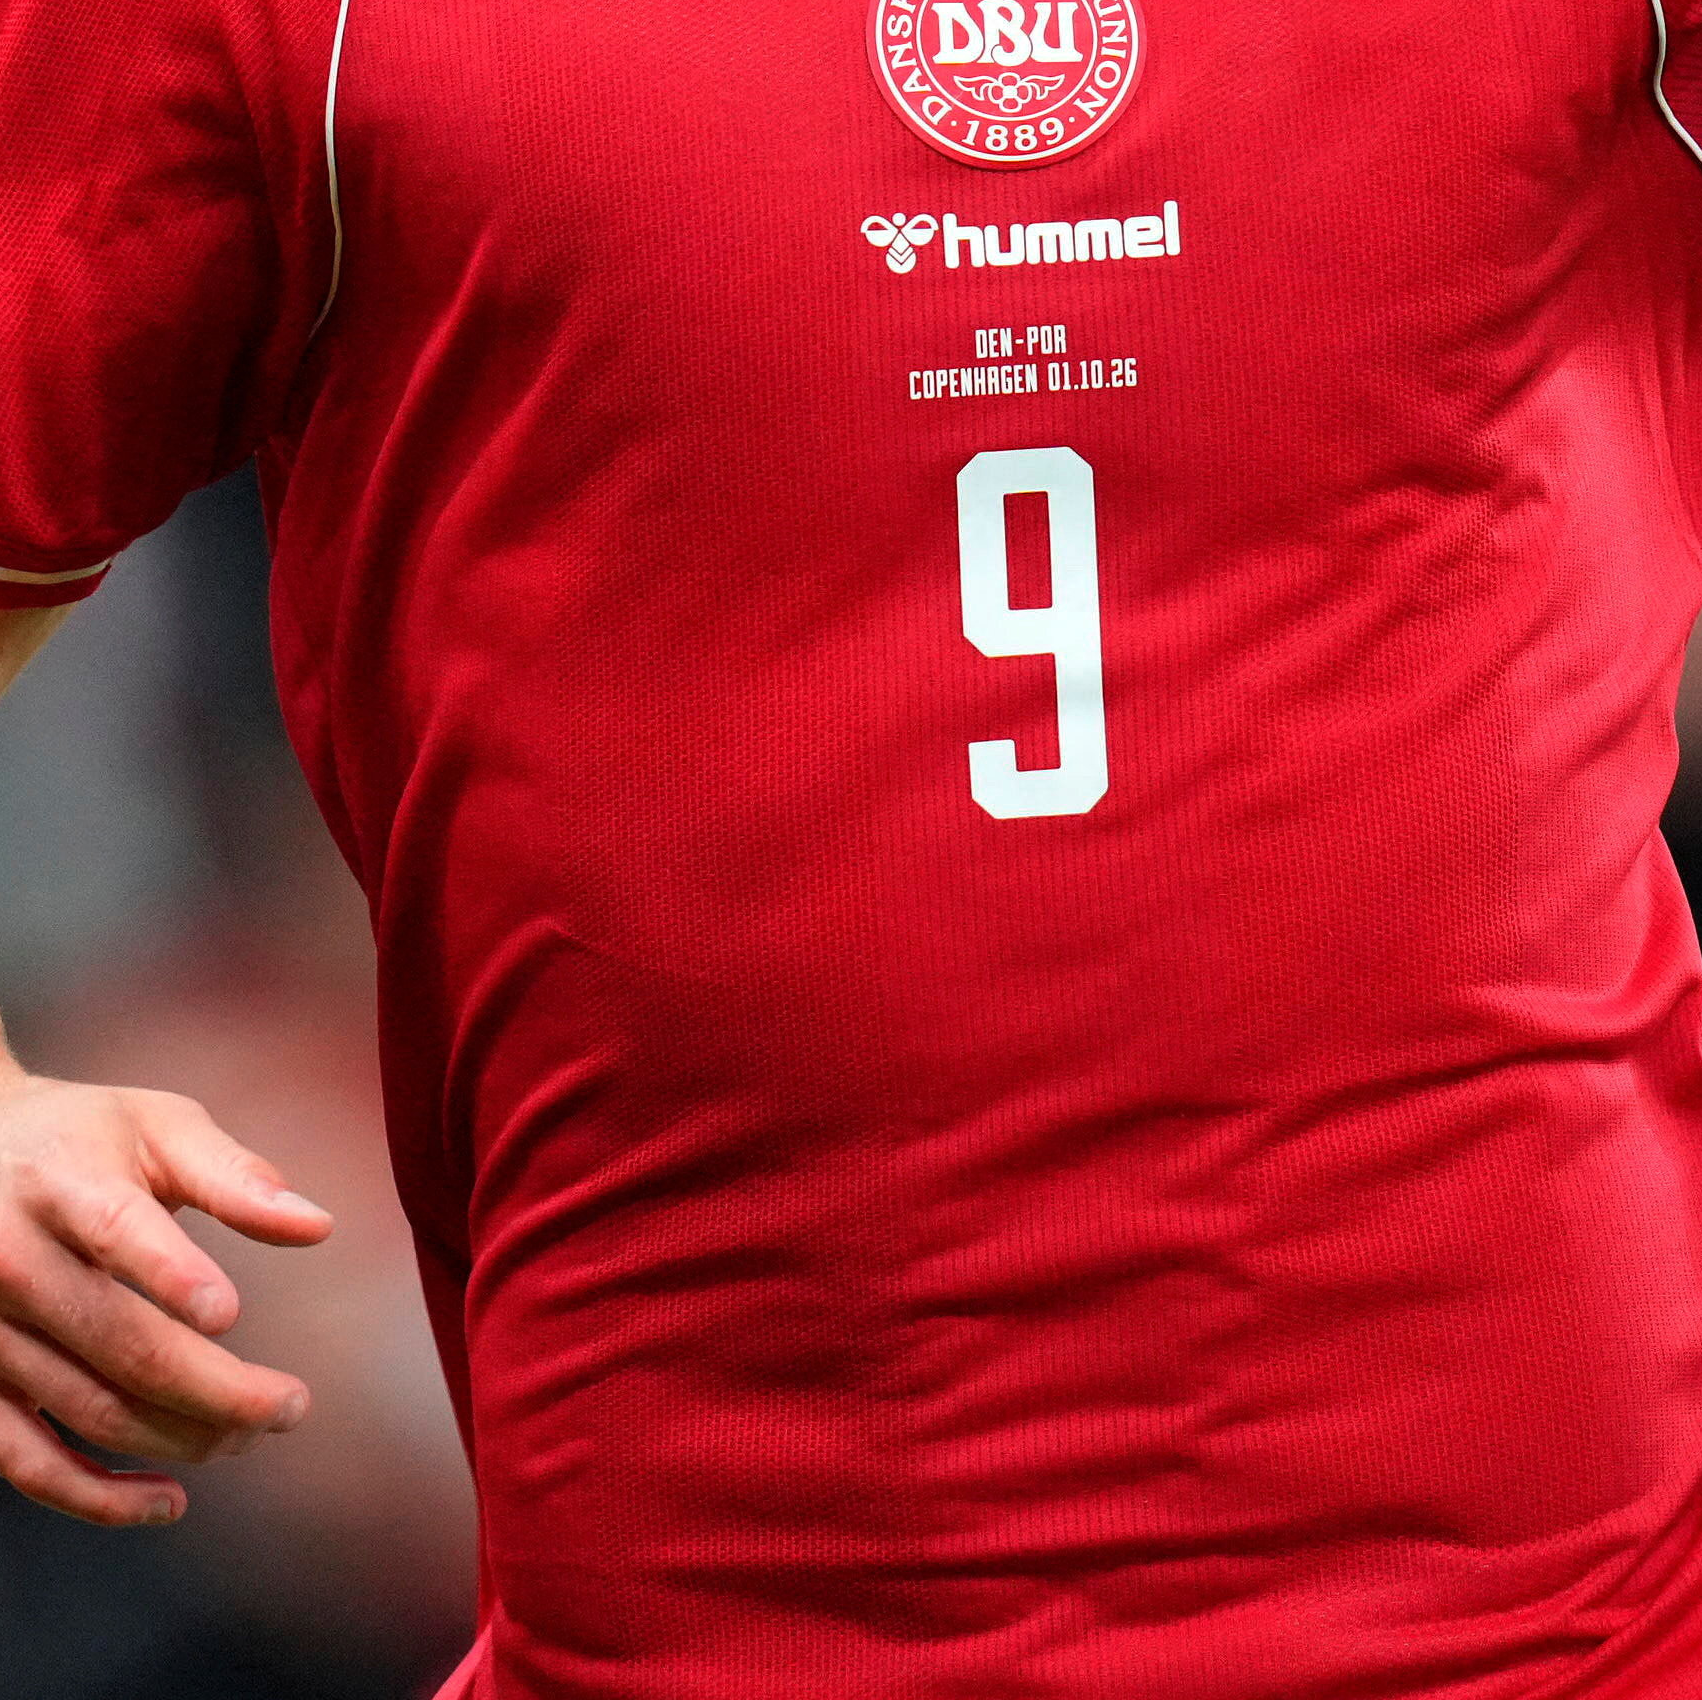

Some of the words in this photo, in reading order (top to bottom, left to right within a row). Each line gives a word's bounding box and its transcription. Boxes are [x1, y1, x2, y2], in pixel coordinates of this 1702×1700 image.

[961, 116, 1065, 152] 1889
[942, 200, 1181, 269] hummel
[974, 324, 1067, 360] DEN-POR
[908, 363, 1039, 400] COPENHAGEN
[1047, 357, 1138, 392] 01.10.26
[955, 446, 1109, 820] 9
